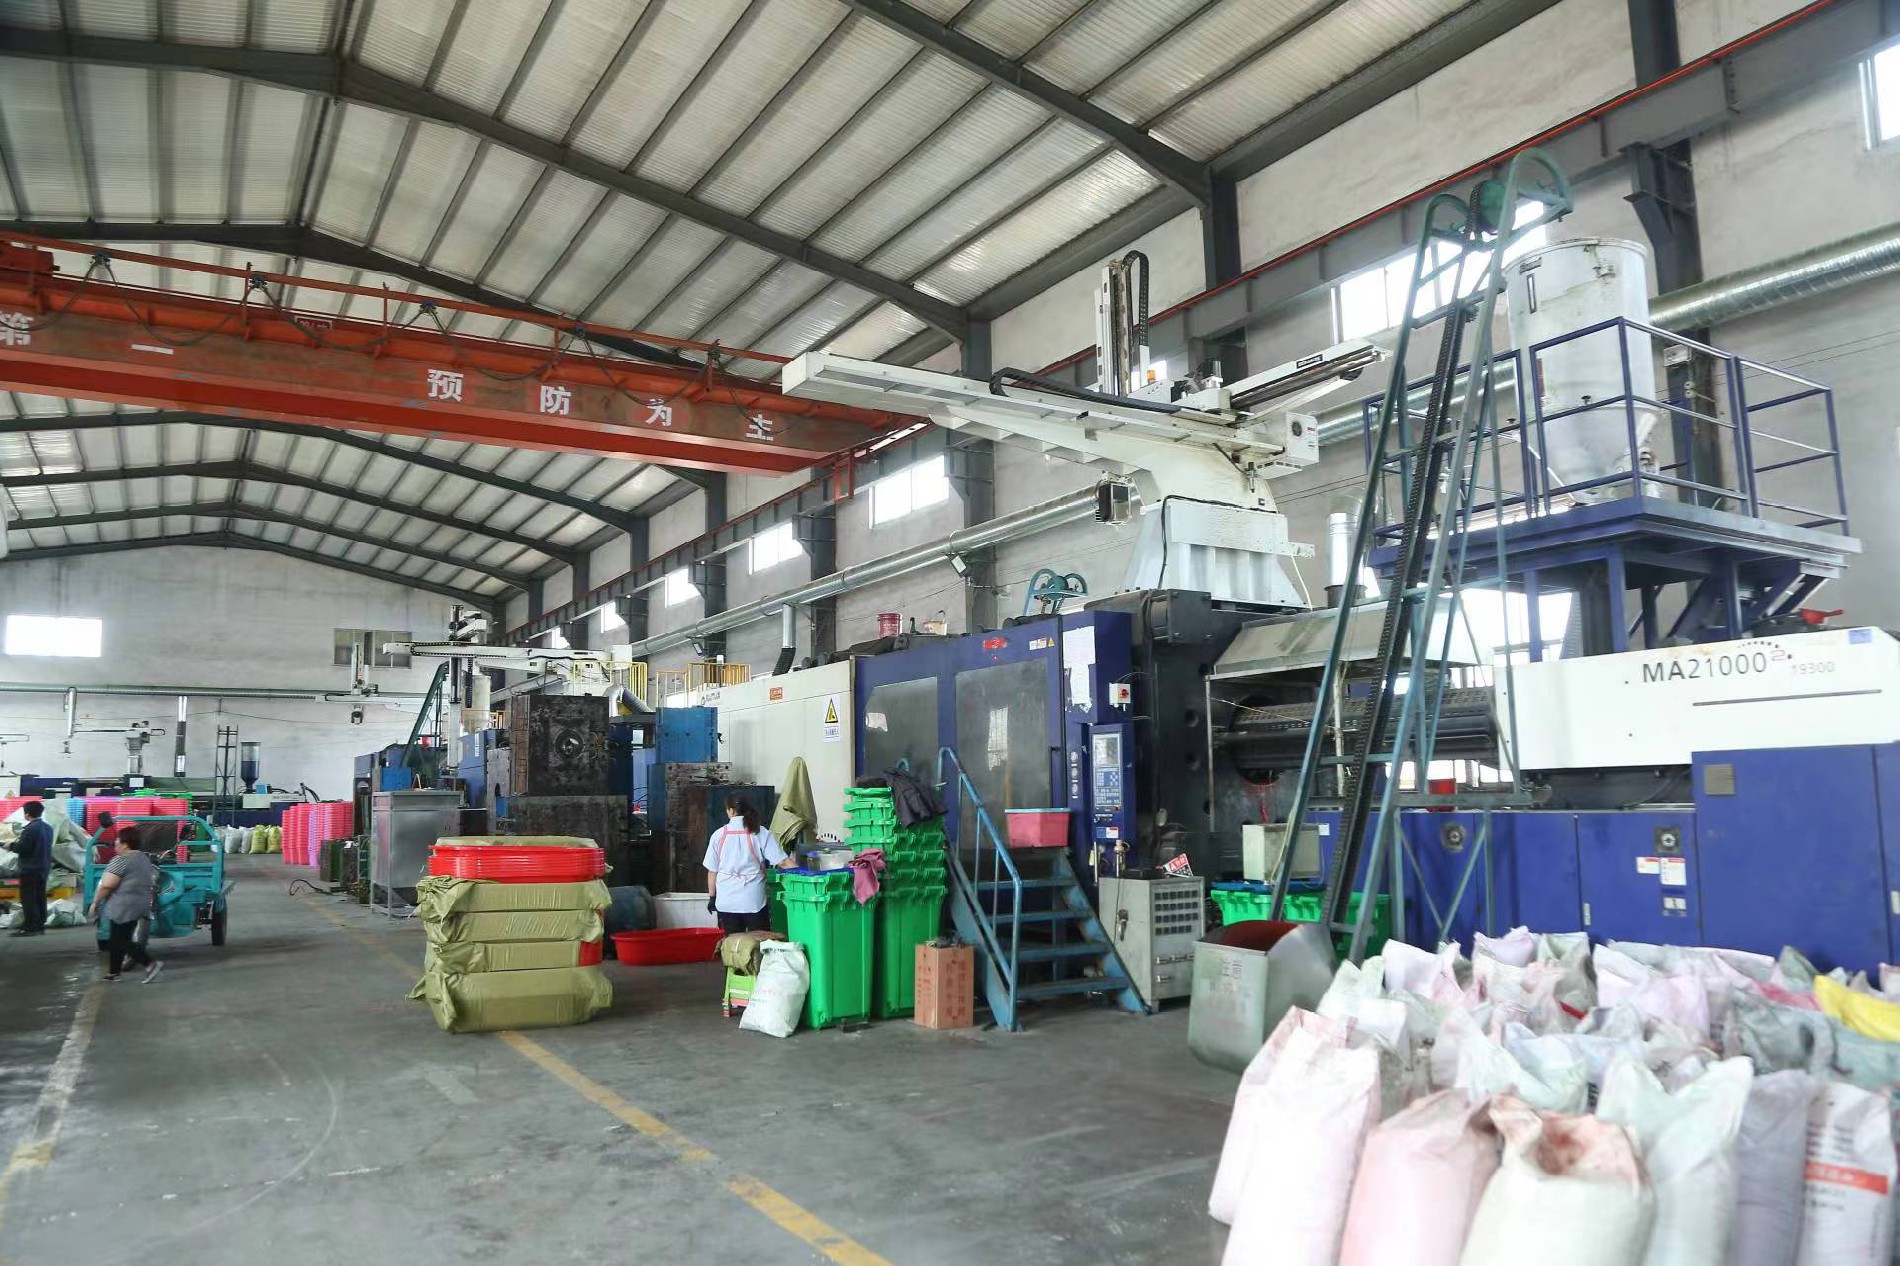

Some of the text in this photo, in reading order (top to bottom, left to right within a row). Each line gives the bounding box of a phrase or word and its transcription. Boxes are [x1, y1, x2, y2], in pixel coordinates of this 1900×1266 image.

[427, 369, 774, 442] 预防为主
[1642, 652, 1768, 683] MA21000
